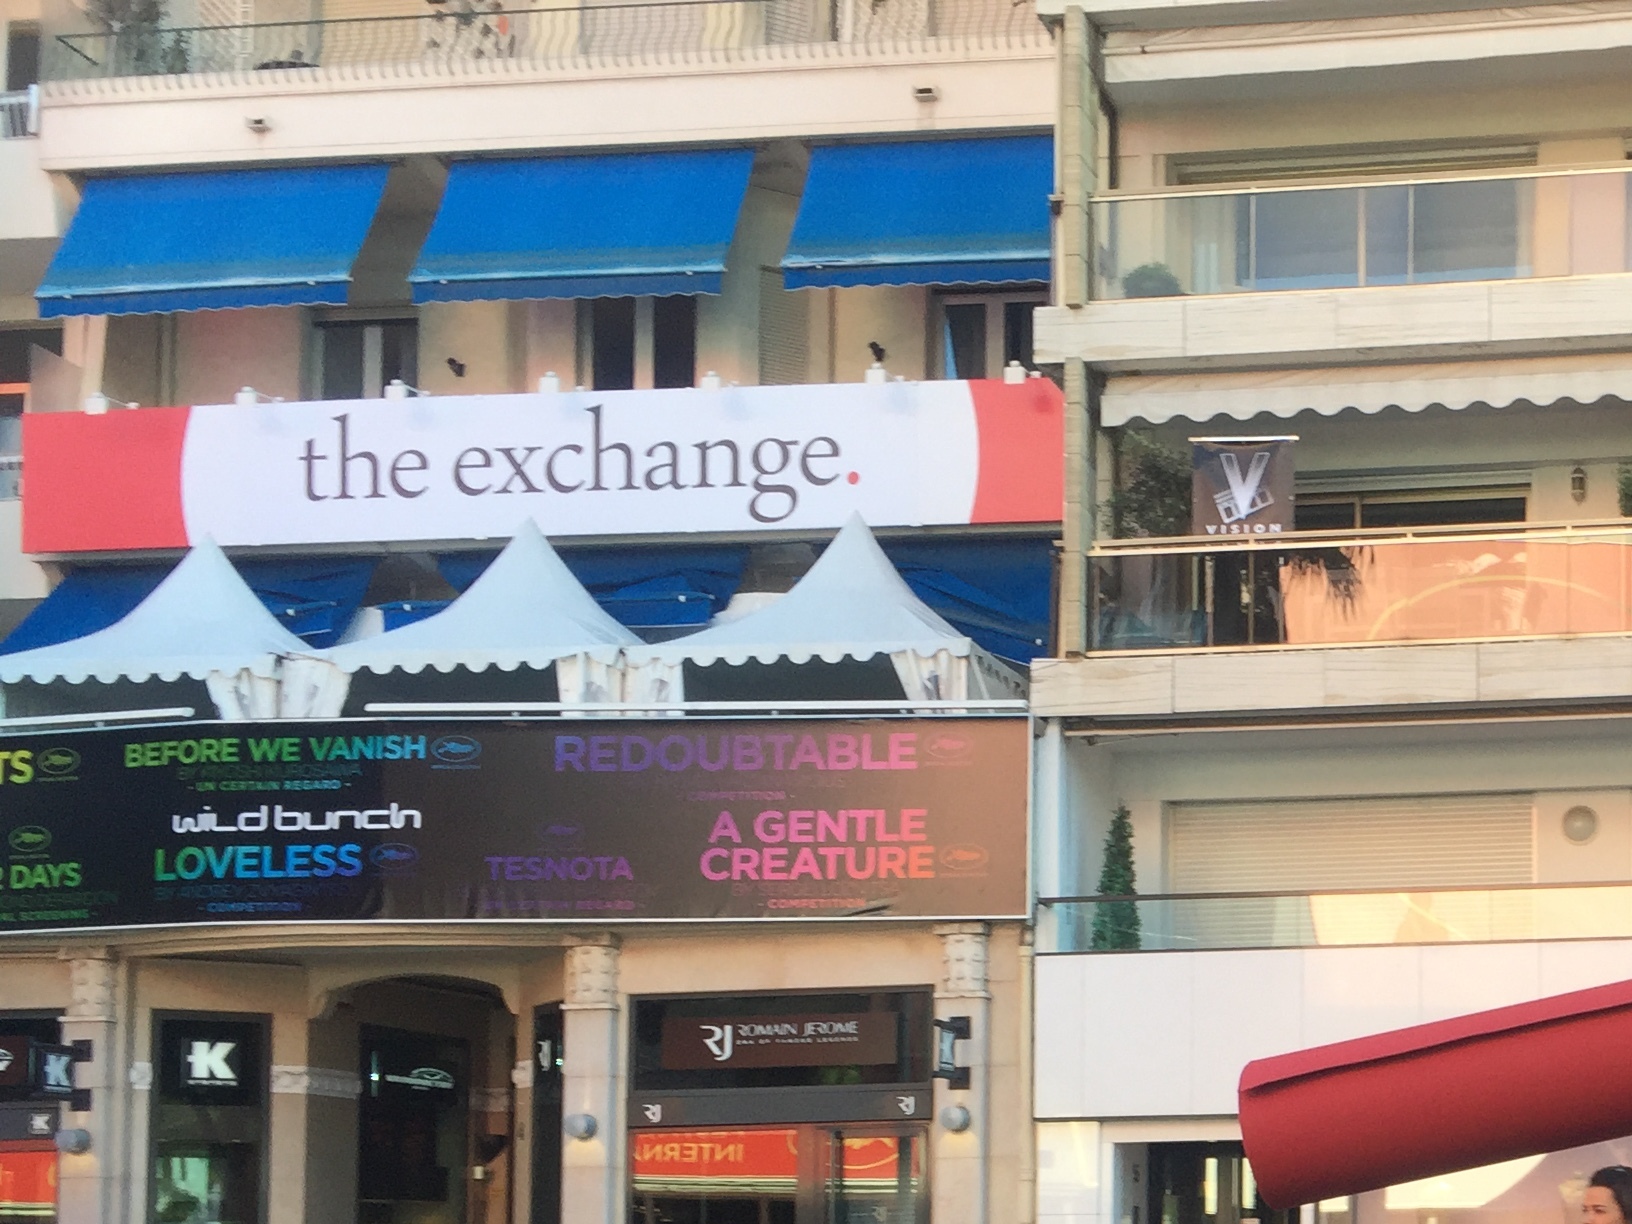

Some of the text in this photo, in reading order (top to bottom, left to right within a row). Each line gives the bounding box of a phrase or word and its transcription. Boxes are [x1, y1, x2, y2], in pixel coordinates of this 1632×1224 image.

[299, 404, 861, 523] the exchange.
[1205, 523, 1282, 534] VISION
[124, 736, 426, 768] BEFORE WE VANISH
[554, 733, 919, 772] REDOUBTABLE
[172, 803, 422, 834] wild bunch
[708, 809, 927, 843] A GENTLE
[9, 863, 82, 889] DAYS
[154, 844, 362, 882] LOVELESS
[484, 856, 634, 880] TESNOTA
[700, 846, 935, 880] CREATURE
[699, 1025, 733, 1061] RJ
[736, 1021, 858, 1036] ROMAIN JEROME
